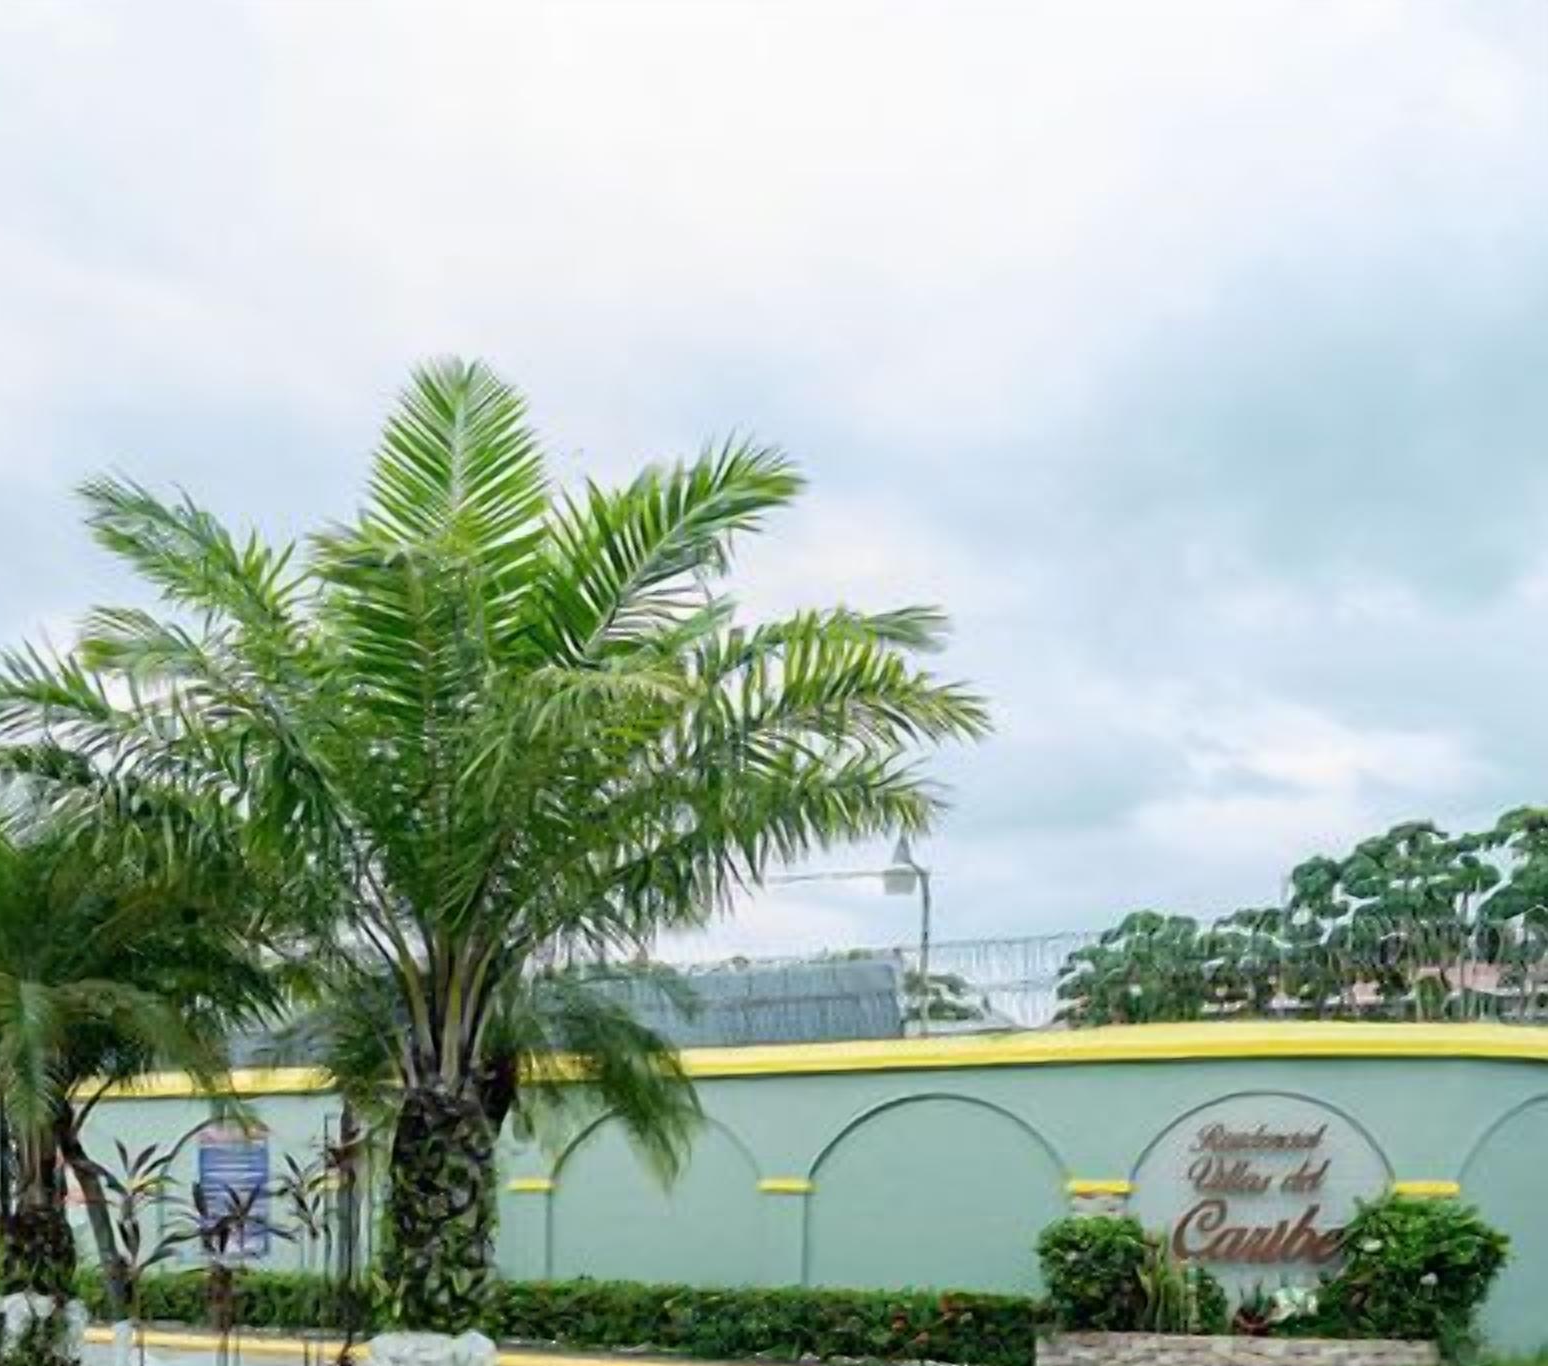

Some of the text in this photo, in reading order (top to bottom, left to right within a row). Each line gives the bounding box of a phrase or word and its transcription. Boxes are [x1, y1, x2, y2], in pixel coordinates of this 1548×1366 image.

[1188, 1158, 1331, 1191] Villas del
[1172, 1199, 1349, 1263] Caribe
